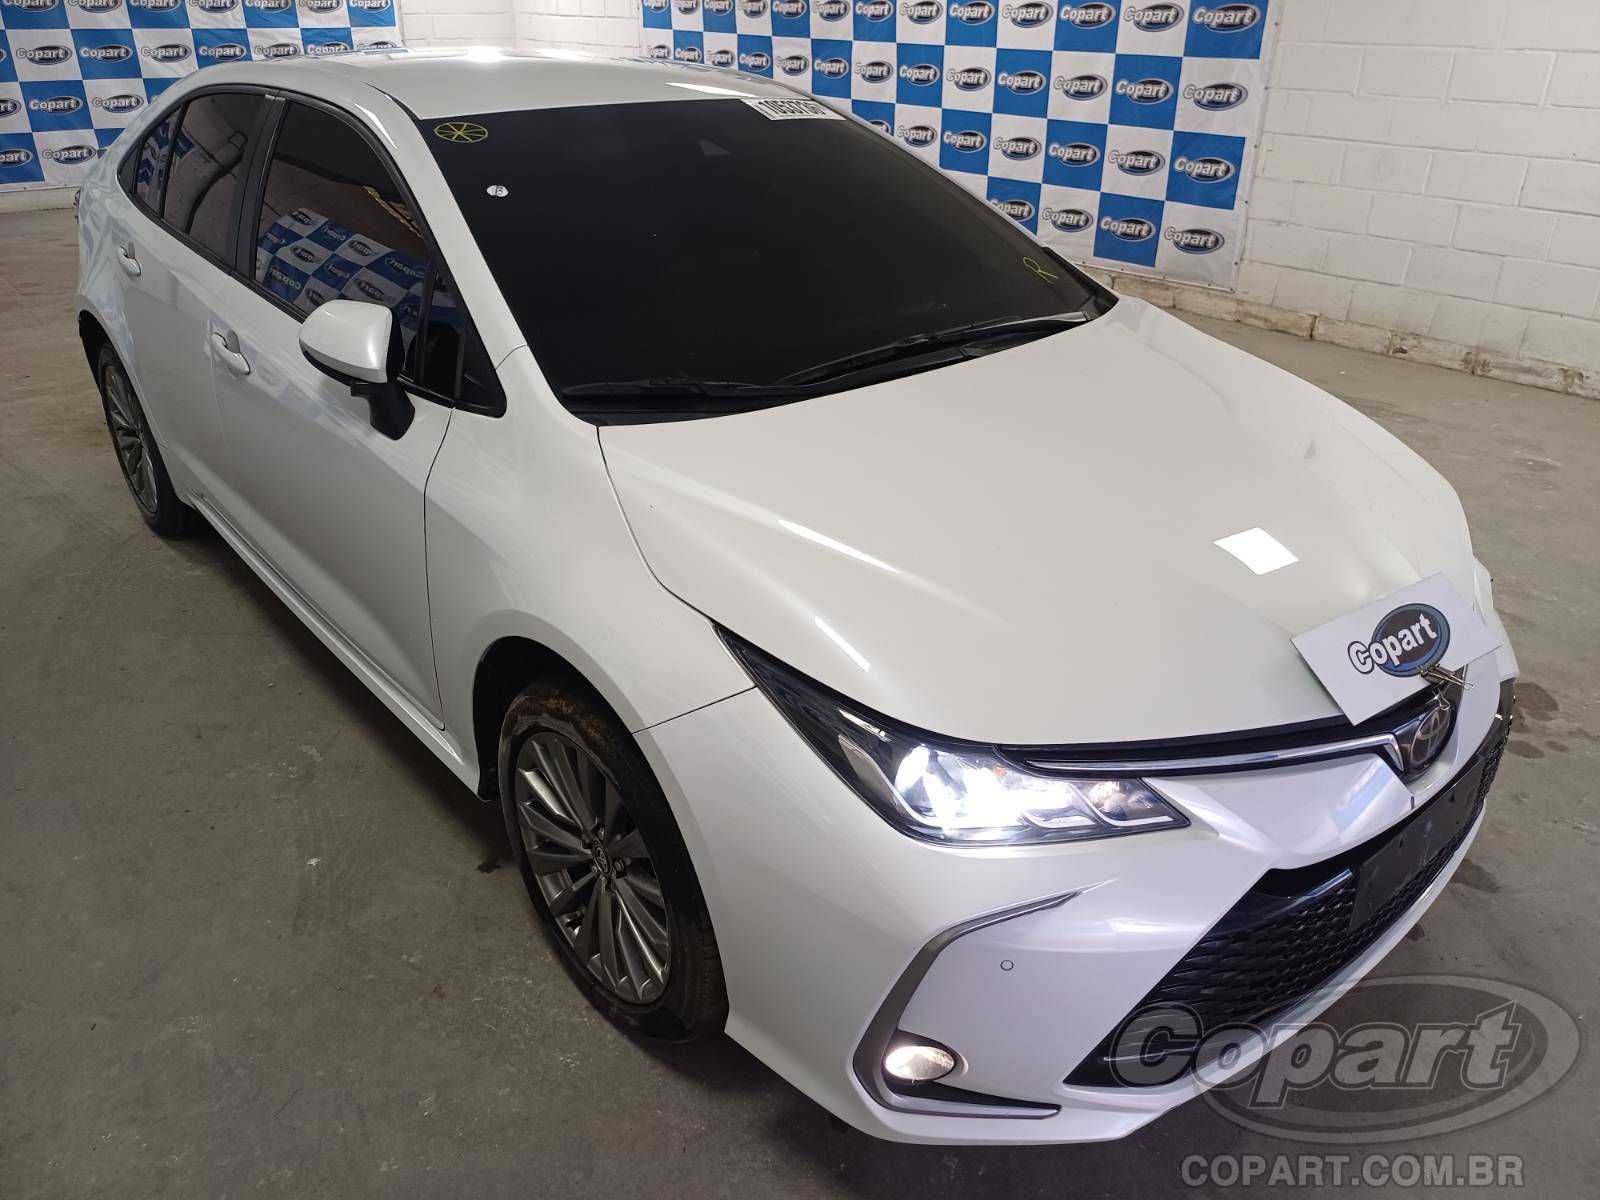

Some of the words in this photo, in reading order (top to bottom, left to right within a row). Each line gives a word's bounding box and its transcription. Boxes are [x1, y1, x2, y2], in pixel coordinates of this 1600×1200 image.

[772, 1, 803, 14] Copart
[813, 1, 844, 15] Copart
[855, 3, 889, 17] Copart
[900, 2, 938, 18] Copart
[950, 3, 989, 19] Copart
[1002, 4, 1046, 20] Copart
[1060, 5, 1108, 23] Copart
[1124, 6, 1177, 25] Copart
[1193, 6, 1251, 27] Copart
[16, 48, 64, 59] Copart
[80, 47, 124, 58] Copart
[141, 46, 184, 57] Copart
[199, 46, 241, 57] Copart
[254, 45, 294, 56] Copart
[740, 54, 768, 68] Copart
[775, 56, 804, 71] Copart
[814, 59, 844, 74] Copart
[855, 63, 888, 78] Copart
[899, 65, 935, 80] Copart
[946, 69, 985, 85] Copart
[998, 73, 1041, 88] Copart
[1053, 77, 1101, 94] Copart
[1116, 80, 1165, 98] Copart
[1184, 84, 1239, 103] Copart
[29, 99, 77, 110] Copart
[92, 97, 138, 108] Copart
[897, 125, 933, 141] Copart
[943, 131, 981, 147] Copart
[993, 137, 1035, 153] Copart
[1049, 143, 1095, 160] Copart
[42, 149, 89, 160] Copart
[1109, 150, 1157, 169] Copart
[1174, 157, 1226, 177] Copart
[1042, 208, 1087, 226] Copart
[1100, 217, 1151, 236] Copart
[1164, 227, 1216, 247] Copart
[1347, 613, 1438, 674] Copart
